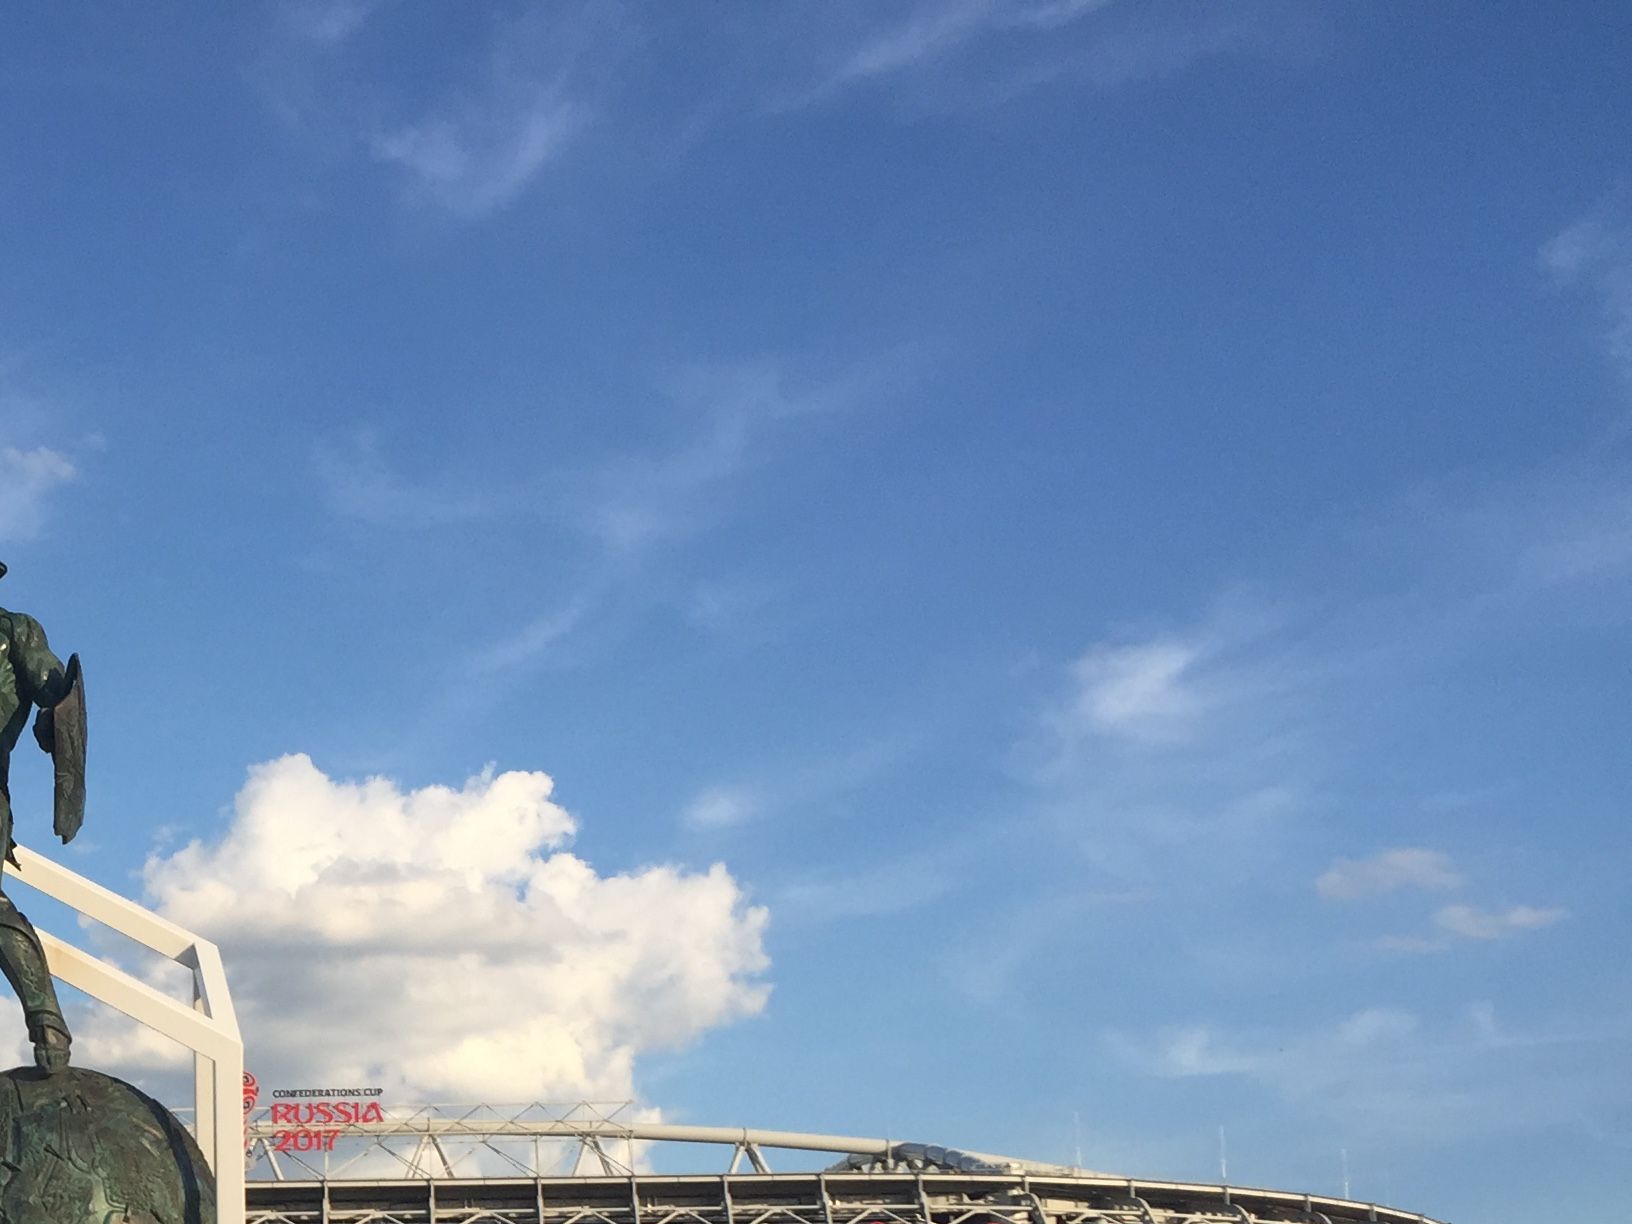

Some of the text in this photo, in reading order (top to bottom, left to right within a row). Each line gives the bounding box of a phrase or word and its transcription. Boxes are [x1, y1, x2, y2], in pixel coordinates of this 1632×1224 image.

[272, 1087, 384, 1099] CONFEDERATIONS CUP
[271, 1101, 384, 1124] RUSSIA
[274, 1128, 341, 1152] 2017
